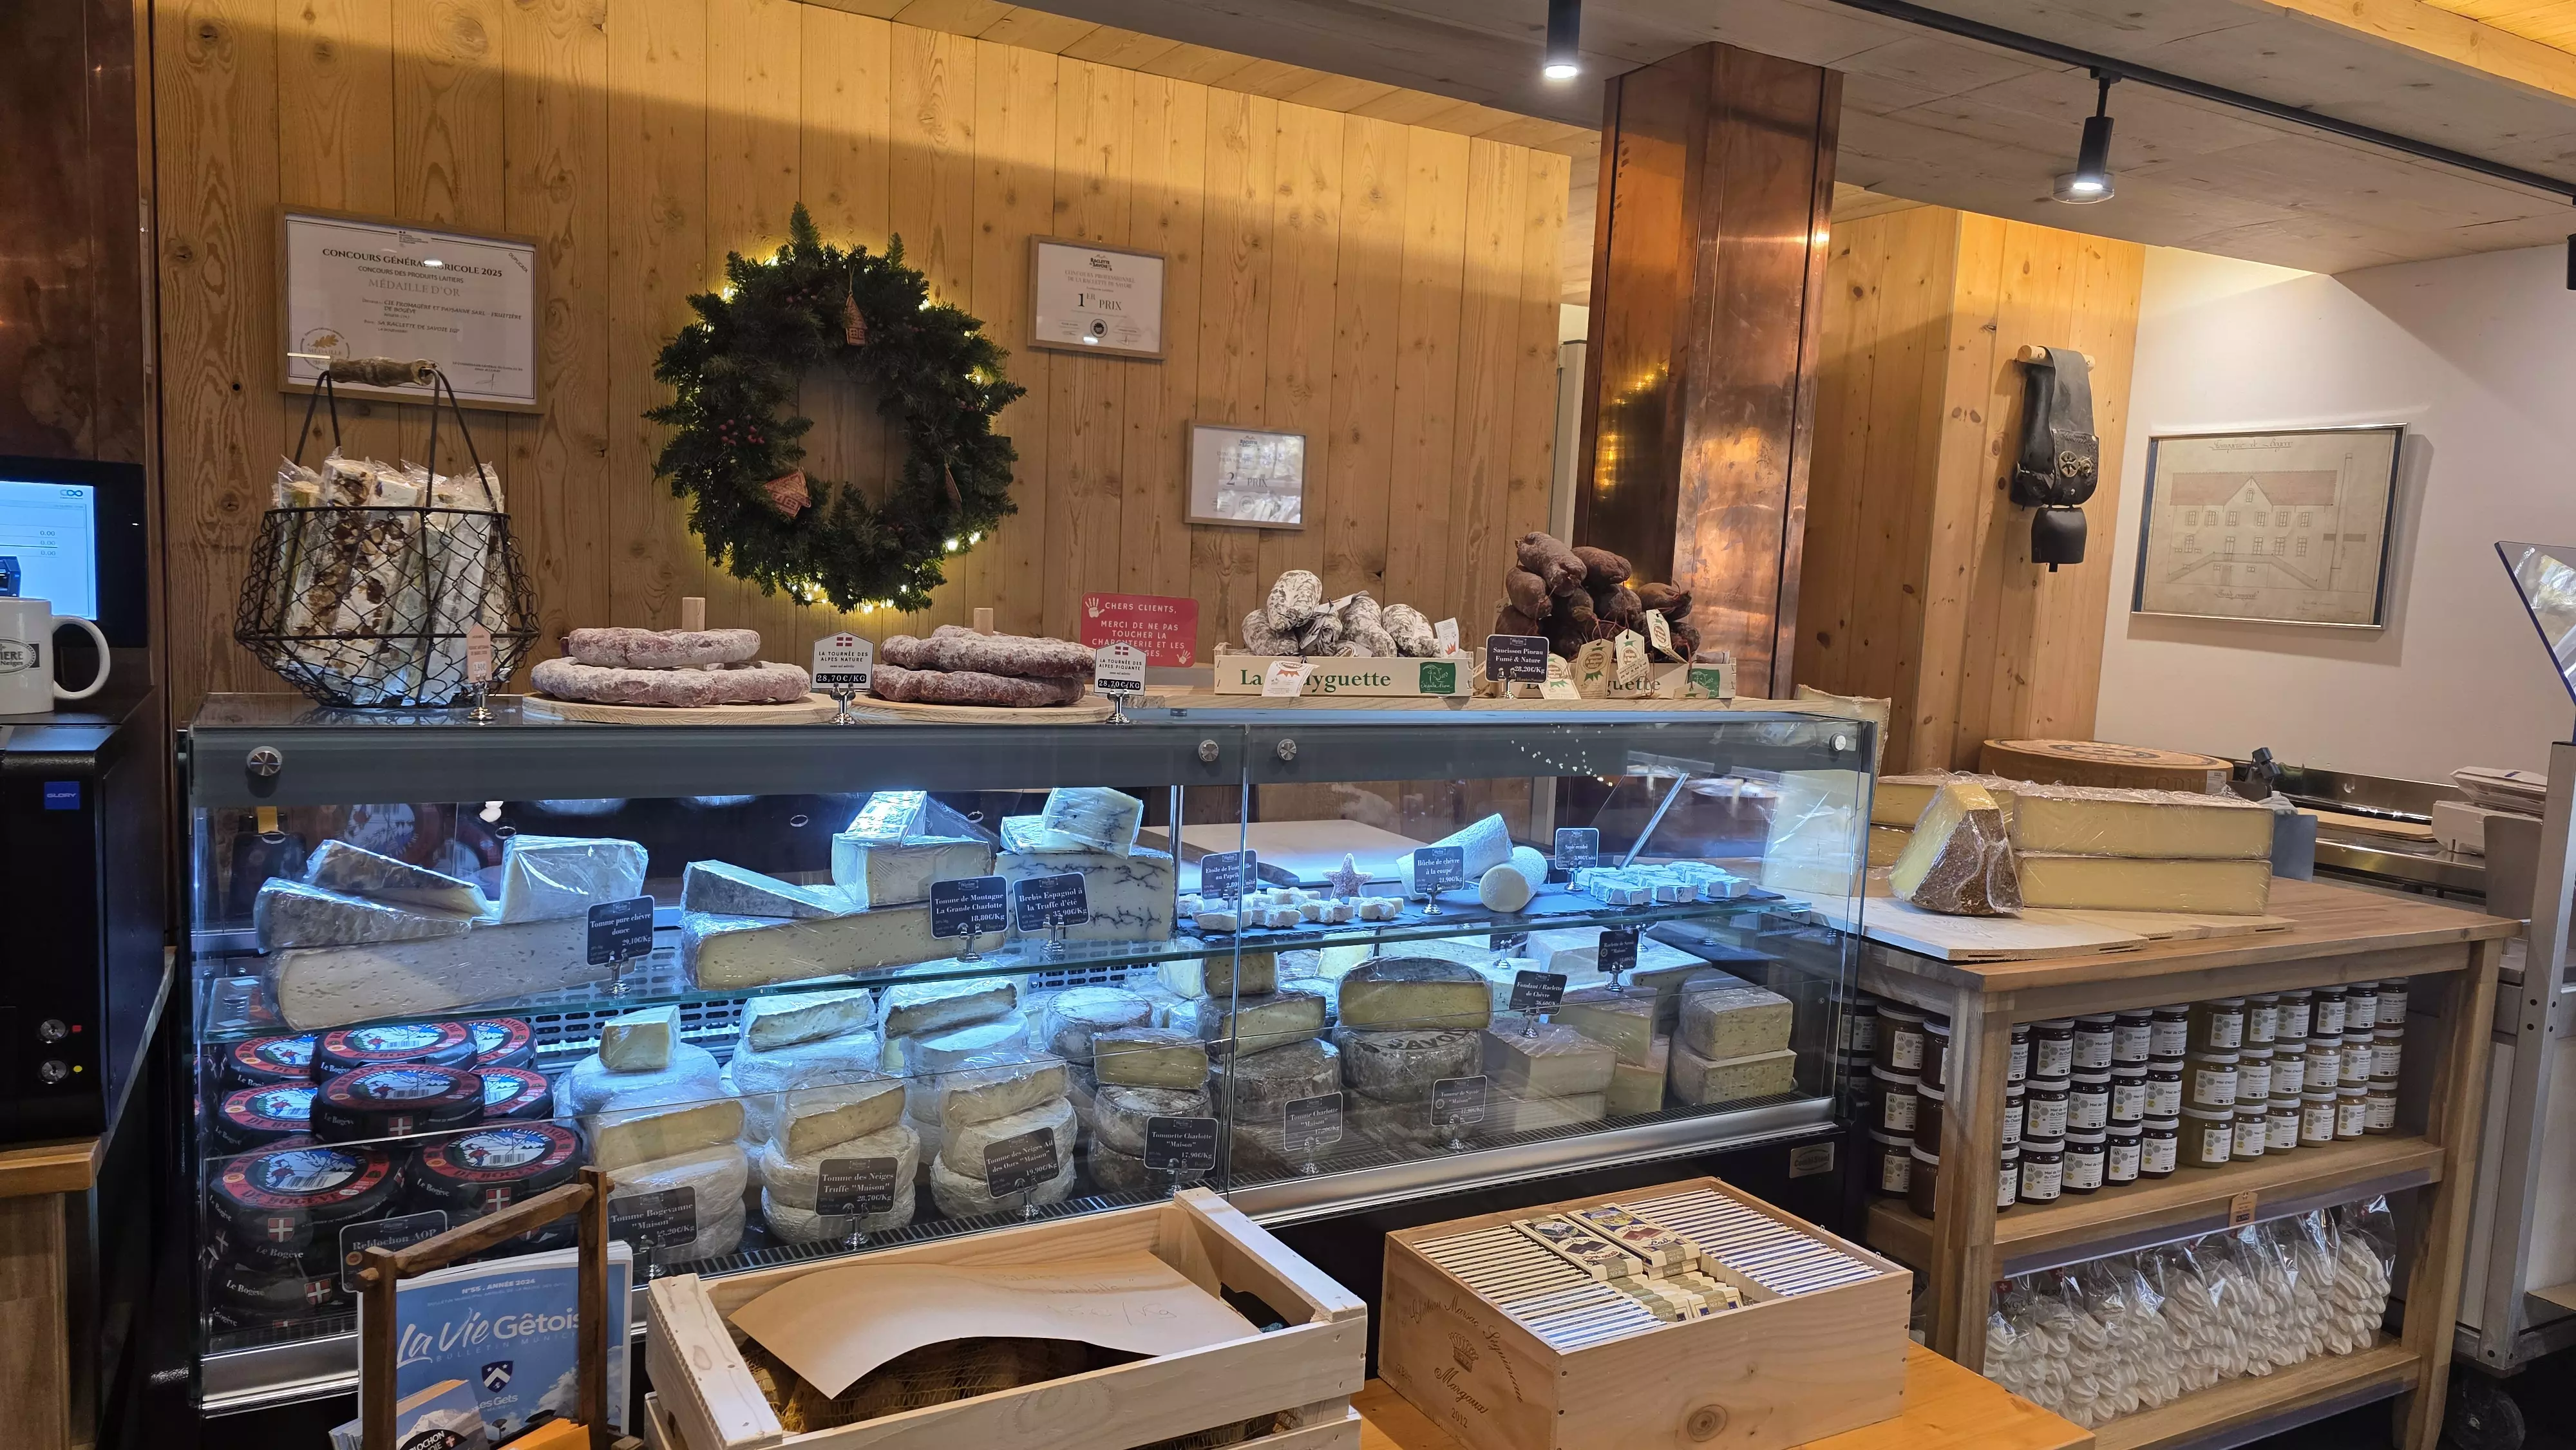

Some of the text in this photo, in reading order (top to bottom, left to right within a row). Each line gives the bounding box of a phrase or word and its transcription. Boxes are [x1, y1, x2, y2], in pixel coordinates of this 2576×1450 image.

[323, 249, 381, 262] CONCOURS
[481, 268, 502, 277] 2025
[508, 252, 528, 273] DUPLICATA
[358, 266, 393, 275] CONCOURS
[408, 272, 437, 280] PRODUITS
[439, 275, 464, 283] LAITIERS
[368, 279, 460, 296] MÉDAILLE D'OR
[1099, 299, 1122, 310] PRIX
[1226, 472, 1268, 488] 2 PRIX
[1105, 602, 1177, 614] CHERS CLIENTS,
[1112, 630, 1153, 639] TOUCHER
[1240, 670, 1262, 686] La
[1019, 894, 1042, 902] Brebis
[1036, 901, 1058, 910] Truffe
[590, 913, 651, 928] Tomme pure chèvre
[321, 1062, 329, 1070] Le
[238, 1074, 245, 1083] Le
[1313, 1108, 1338, 1116] Charlotte
[1301, 1118, 1328, 1127] "Maison"
[986, 1154, 1010, 1165] Tomme
[1023, 1145, 1042, 1154] Neiges
[1044, 1140, 1054, 1148] Ail
[1020, 1149, 1050, 1163] "Maison"
[869, 1172, 894, 1182] Neiges
[417, 1178, 450, 1196] Le Bogève
[852, 1183, 890, 1192] "Maison"
[611, 1203, 694, 1223] Tomme Bogévanne
[632, 1217, 674, 1229] "Maison"
[353, 1229, 437, 1250] Reblochon AOP
[270, 1248, 303, 1259] Bogève
[226, 1279, 265, 1296] Le Bogève
[487, 1280, 515, 1290] ANNÉE
[1444, 1294, 1479, 1327] Marsac
[397, 1324, 433, 1370] La
[439, 1307, 489, 1351] Vie
[436, 1342, 509, 1362] BULLETIN
[1434, 1367, 1490, 1414] Margaux
[495, 1393, 518, 1408] Gets
[1451, 1408, 1468, 1429] 2012
